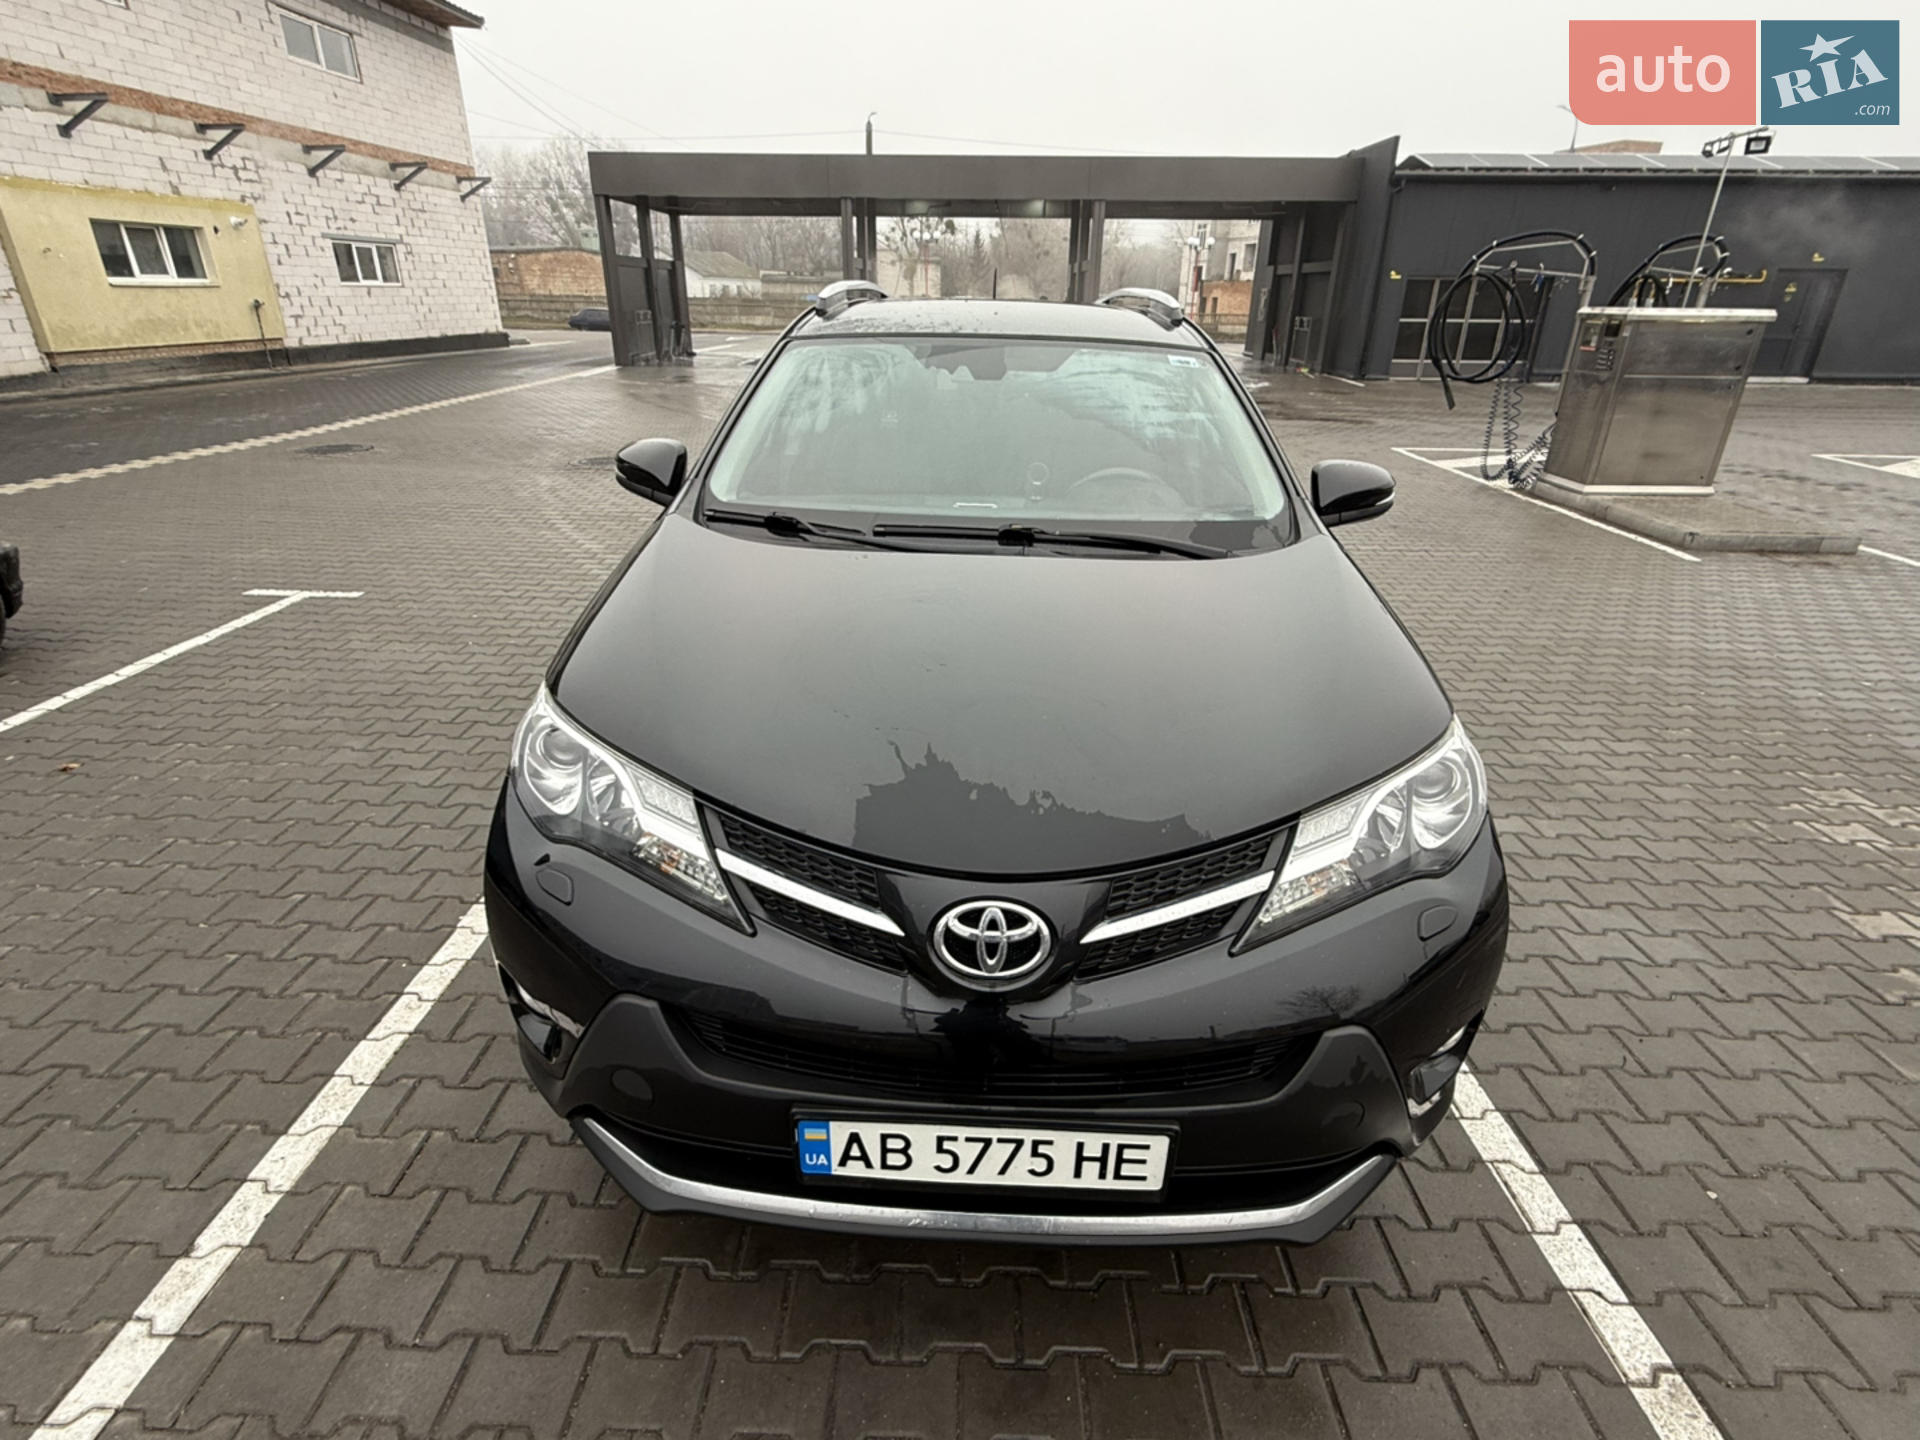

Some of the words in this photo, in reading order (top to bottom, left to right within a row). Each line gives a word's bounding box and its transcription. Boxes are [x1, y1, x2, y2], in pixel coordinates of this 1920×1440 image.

[805, 1152, 829, 1167] UA
[836, 1131, 913, 1171] AB
[932, 1135, 1055, 1177] 5775
[1072, 1141, 1151, 1181] HE
